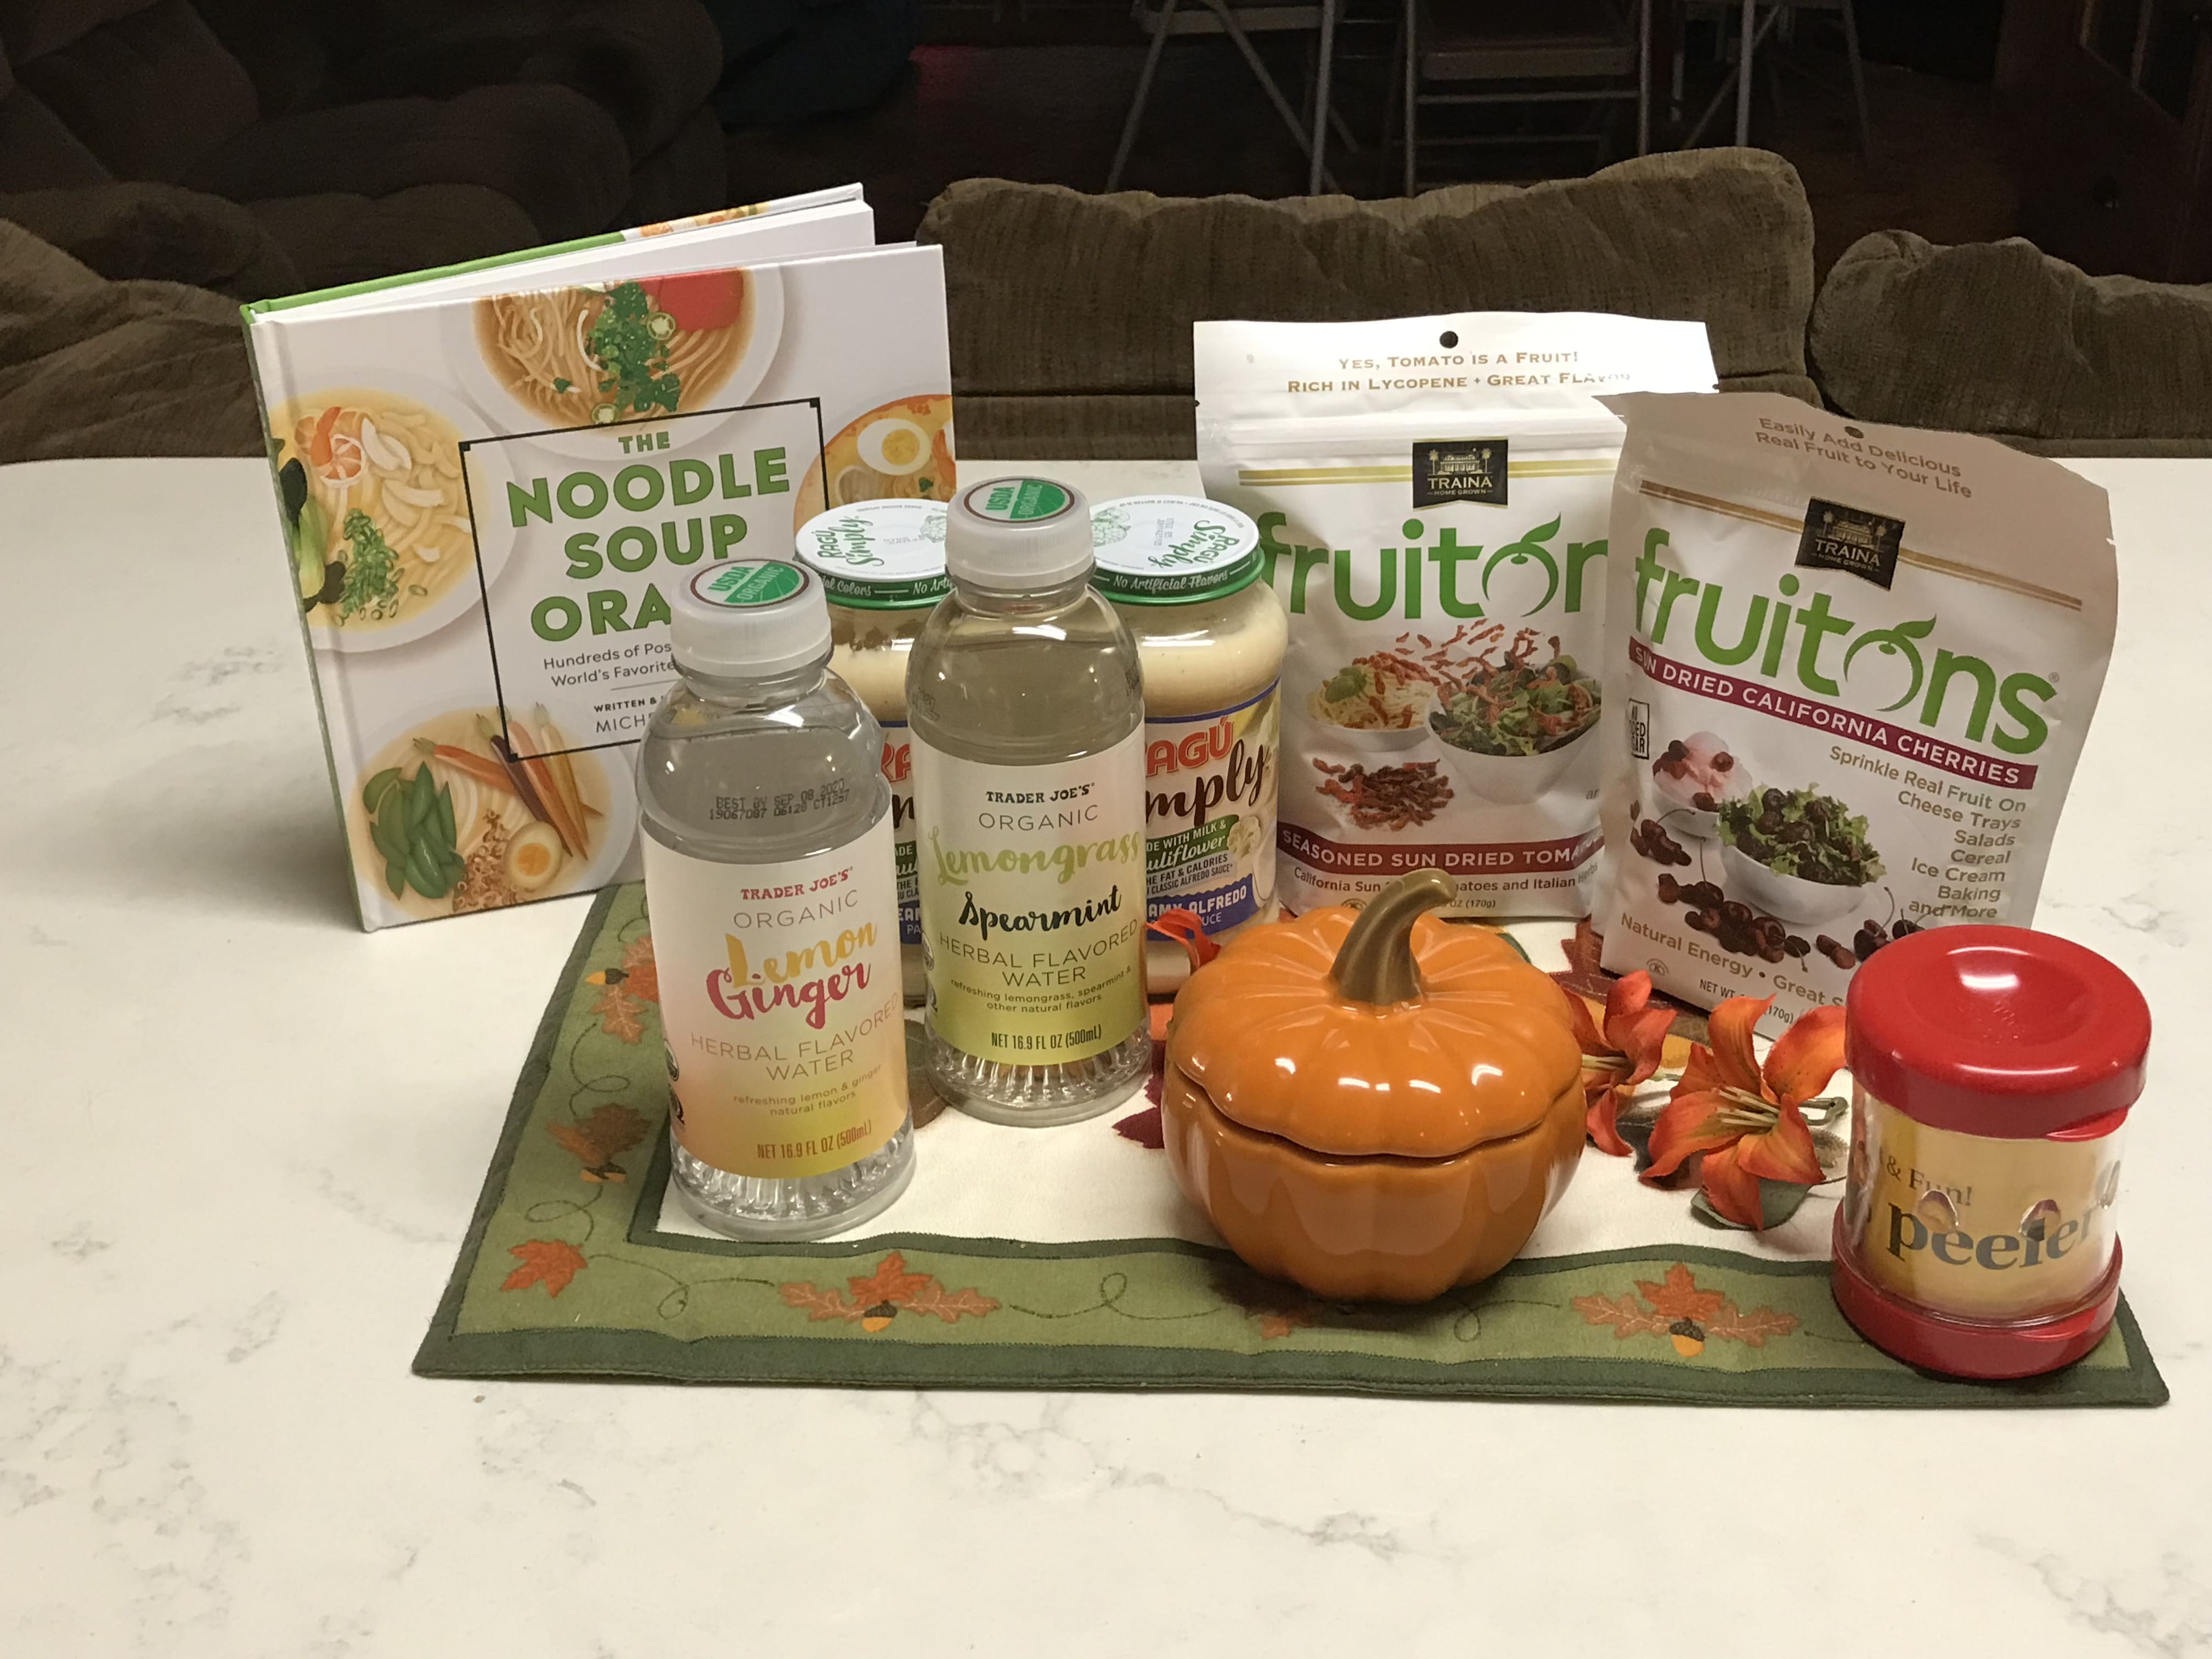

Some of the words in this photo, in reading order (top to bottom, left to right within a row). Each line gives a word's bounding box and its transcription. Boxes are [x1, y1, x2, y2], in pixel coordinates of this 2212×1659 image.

[1387, 355, 1465, 368] TOMATO
[1471, 353, 1488, 365] IS
[1496, 353, 1508, 364] A
[1516, 351, 1578, 363] FRUIT!
[1288, 380, 1333, 393] RICH
[1341, 380, 1360, 391] IN
[1369, 377, 1468, 390] LYCOPENE
[1487, 373, 1551, 386] GREAT
[618, 431, 670, 454] THE
[1759, 417, 1816, 439] Easily
[1822, 432, 1863, 453] Add
[1868, 445, 1962, 477] Delicious
[1756, 431, 1800, 450] Real
[1805, 441, 1850, 464] Fruit
[1855, 455, 1876, 470] to
[1881, 461, 1929, 485] Your
[1936, 478, 1973, 498] Life
[505, 446, 790, 528] NOODLE
[1427, 476, 1493, 489] TRAINA
[985, 487, 1015, 511] USDA
[1018, 483, 1043, 516] ORGANIC
[563, 513, 748, 580] SOUP
[828, 516, 885, 567] Simply
[1148, 520, 1226, 568] Simply
[1815, 538, 1881, 567] TRAINA
[707, 566, 755, 592] USDA
[736, 566, 785, 601] ORGANIC
[837, 579, 871, 597] Colors
[912, 581, 928, 595] No
[1113, 574, 1128, 588] No
[1130, 575, 1186, 595] Artificial
[1188, 570, 1228, 589] Flavors
[530, 582, 672, 642] ORA
[543, 649, 620, 670] Hundreds
[624, 645, 640, 658] of
[644, 643, 672, 656] Pos
[1635, 527, 2057, 755] fruitons
[550, 669, 610, 687] World's
[593, 698, 646, 713] WRITTEN
[649, 696, 657, 705] &
[596, 714, 646, 733] MICH
[1663, 663, 1734, 697] DRIED
[1742, 687, 1889, 746] CALIFORNIA
[1897, 734, 2020, 785] CHERRIES
[1147, 716, 1233, 777] AGÚ
[715, 795, 746, 810] BEST
[753, 796, 768, 809] BY
[774, 793, 795, 806] SEP
[800, 788, 815, 802] 08
[820, 778, 845, 798] 2020
[986, 790, 1045, 804] TRADER
[1049, 783, 1092, 802] JOE'S
[1146, 739, 1269, 827] mply
[1829, 745, 1899, 780] Sprinkle
[1904, 770, 1943, 795] Real
[1947, 785, 1993, 809] Fruit
[1999, 798, 2027, 812] On
[978, 804, 1098, 831] ORGANIC
[1897, 790, 1963, 823] Cheese
[1970, 812, 2021, 831] Trays
[1163, 832, 1190, 849] WITH
[1193, 822, 1217, 840] MILK
[1219, 819, 1227, 830] &
[1282, 830, 1383, 867] SEASONED
[1391, 853, 1437, 867] SUN
[1444, 851, 1515, 867] DRIED
[1953, 830, 2016, 847] Salads
[928, 826, 1141, 886] Lemongrass
[1147, 835, 1226, 871] uliflower
[1160, 870, 1176, 882] FAT
[1178, 868, 1184, 877] &
[1186, 853, 1228, 875] CALORIES
[1950, 849, 2011, 865] Cereal
[740, 883, 805, 900] TRADER
[809, 868, 851, 893] JOE'S
[1152, 879, 1179, 895] CLASSIC
[1180, 870, 1210, 887] ALFREDO
[1294, 866, 1351, 892] California
[1355, 881, 1381, 893] Sun
[1502, 878, 1528, 891] and
[1533, 877, 1576, 890] Italian
[1911, 857, 1939, 877] Ice
[1945, 867, 2006, 883] Cream
[733, 889, 859, 929] ORGANIC
[1465, 899, 1497, 909] (170g)
[1909, 900, 1944, 918] and
[1951, 904, 1997, 919] More
[1937, 885, 2001, 903] Baking
[958, 885, 1122, 941] Spearmint
[724, 922, 878, 988] Lemon
[940, 931, 1023, 968] HERBAL
[1033, 918, 1138, 968] FLAVORED
[1621, 912, 1683, 952] Natural
[1688, 943, 1754, 979] Energy
[1773, 974, 1826, 1005] Great
[950, 978, 1001, 1002] refreshing
[1005, 991, 1075, 1006] lemongrass,
[1077, 973, 1124, 996] spearmint
[1002, 966, 1086, 987] WATER
[706, 962, 872, 1030] Ginger
[986, 1001, 1018, 1013] other
[1021, 1001, 1063, 1013] natural
[1066, 994, 1103, 1010] flavors
[1700, 978, 1719, 994] NET
[1763, 1005, 1794, 1025] 170g)
[691, 1032, 788, 1062] HERBAL
[799, 992, 900, 1058] FLAVORED
[991, 1031, 1008, 1048] NET
[1012, 1034, 1034, 1050] 16.9
[1036, 1035, 1048, 1050] FL
[1049, 1032, 1063, 1049] OZ
[1065, 1024, 1102, 1049] (500mL)
[766, 1049, 853, 1081] WATER
[733, 1094, 796, 1107] refreshing
[800, 1088, 838, 1103] lemon
[840, 1083, 849, 1092] &
[851, 1064, 882, 1088] ginger
[769, 1104, 815, 1116] natural
[817, 1091, 857, 1110] flavors
[757, 1142, 777, 1159] NET
[780, 1140, 803, 1159] 16.9
[805, 1139, 818, 1155] FL
[821, 1135, 834, 1153] OZ
[836, 1120, 872, 1151] (500mL)
[1886, 1155, 1902, 1182] &
